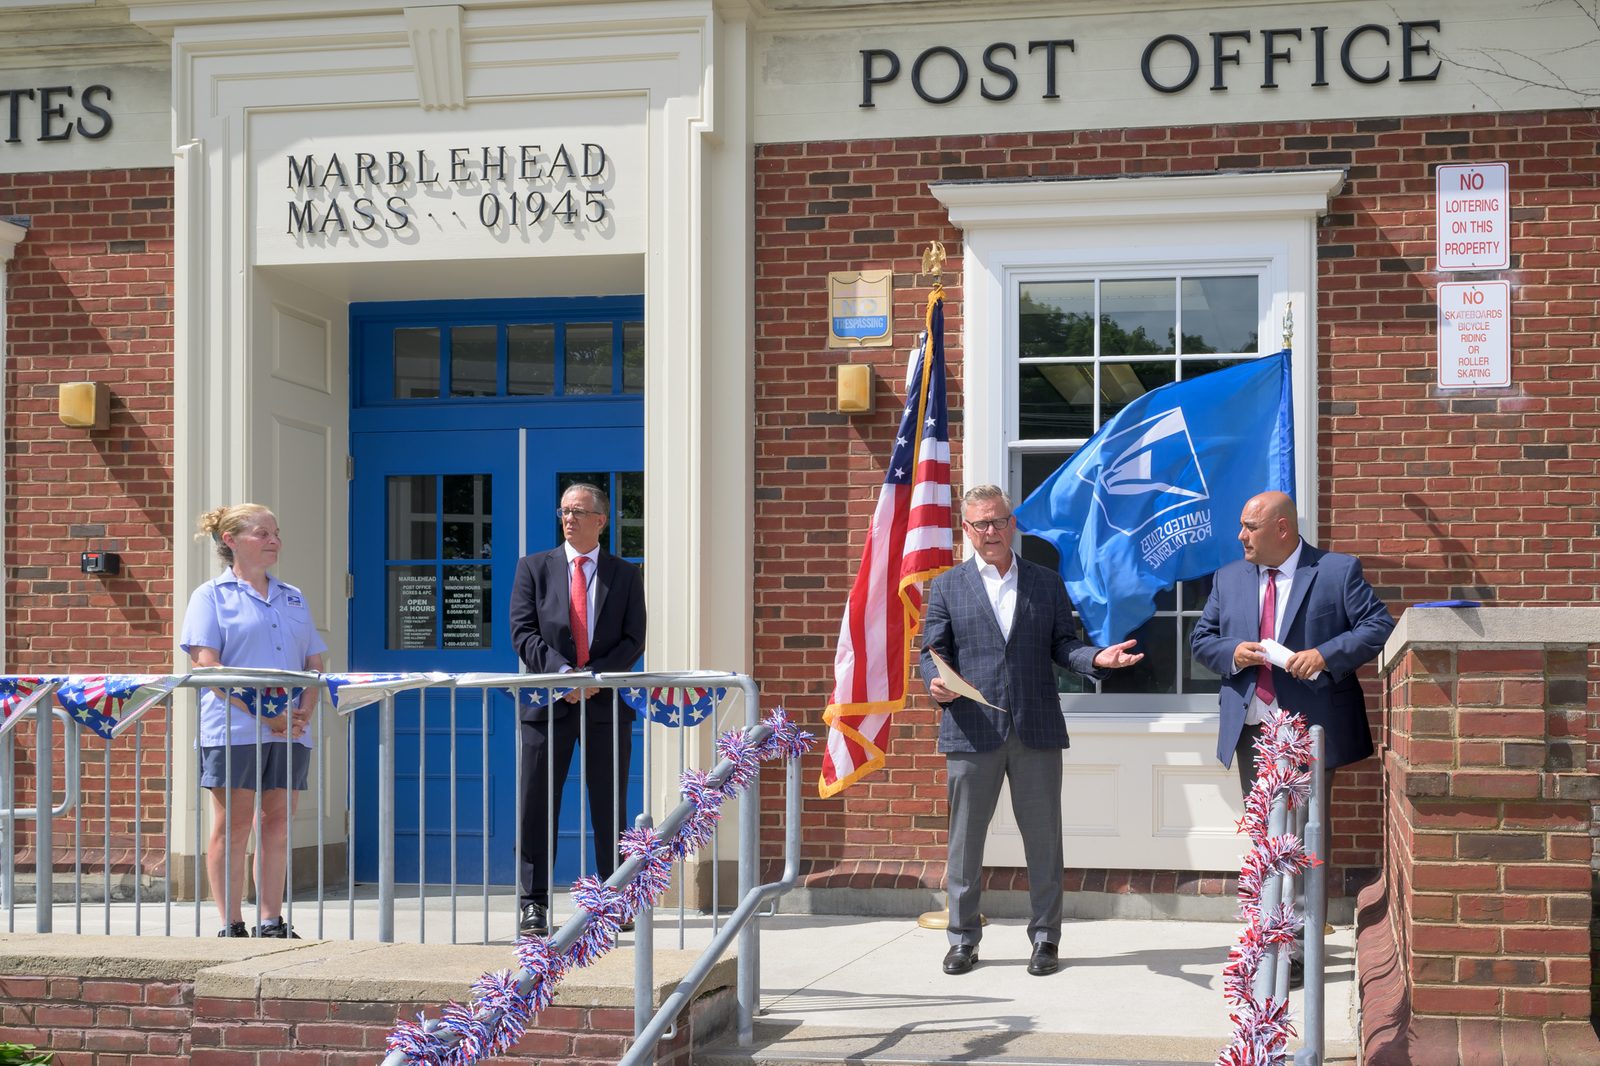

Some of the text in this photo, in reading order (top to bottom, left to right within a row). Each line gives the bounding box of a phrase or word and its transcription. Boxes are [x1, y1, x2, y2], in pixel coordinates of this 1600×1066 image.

[859, 20, 1442, 107] POST OFFICE
[0, 84, 113, 143] TES
[287, 143, 606, 189] MARBLEHEAD
[1460, 173, 1485, 190] NO
[287, 189, 607, 234] MASS 01945
[1445, 198, 1499, 213] LOITERING
[1452, 220, 1493, 234] ON THIS
[1445, 241, 1500, 255] PROPERTY
[1463, 291, 1485, 305] NO
[1445, 309, 1503, 320] SKATEBOARDS
[836, 318, 884, 330] TRESPASSING
[1458, 321, 1490, 331] BICYCLE
[1460, 333, 1487, 343] RIDING
[1468, 345, 1480, 354] OR
[1458, 357, 1490, 367] ROLLER
[1457, 369, 1491, 378] SKATING
